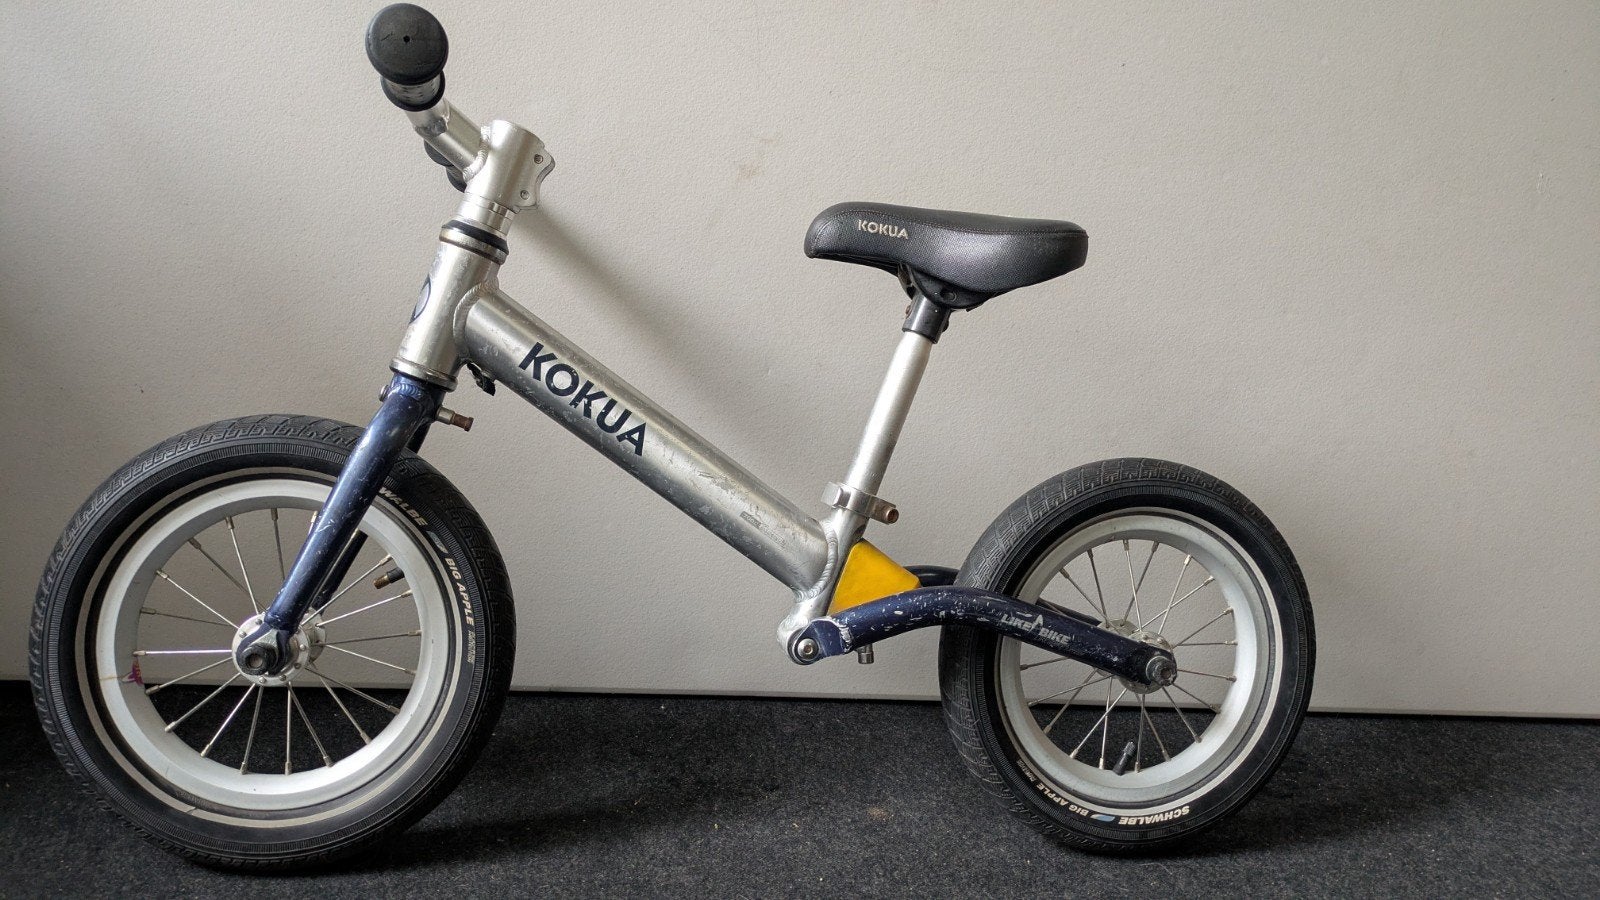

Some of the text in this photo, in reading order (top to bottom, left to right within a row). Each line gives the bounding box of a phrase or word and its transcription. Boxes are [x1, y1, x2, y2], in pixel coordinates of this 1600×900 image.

[858, 219, 909, 240] KOKUA
[518, 341, 647, 457] KOKUA
[378, 487, 428, 526] WALBE
[446, 558, 461, 580] BIG
[457, 583, 474, 626] APPLE
[1036, 783, 1190, 825] SCHWALBE BIG APPLE
